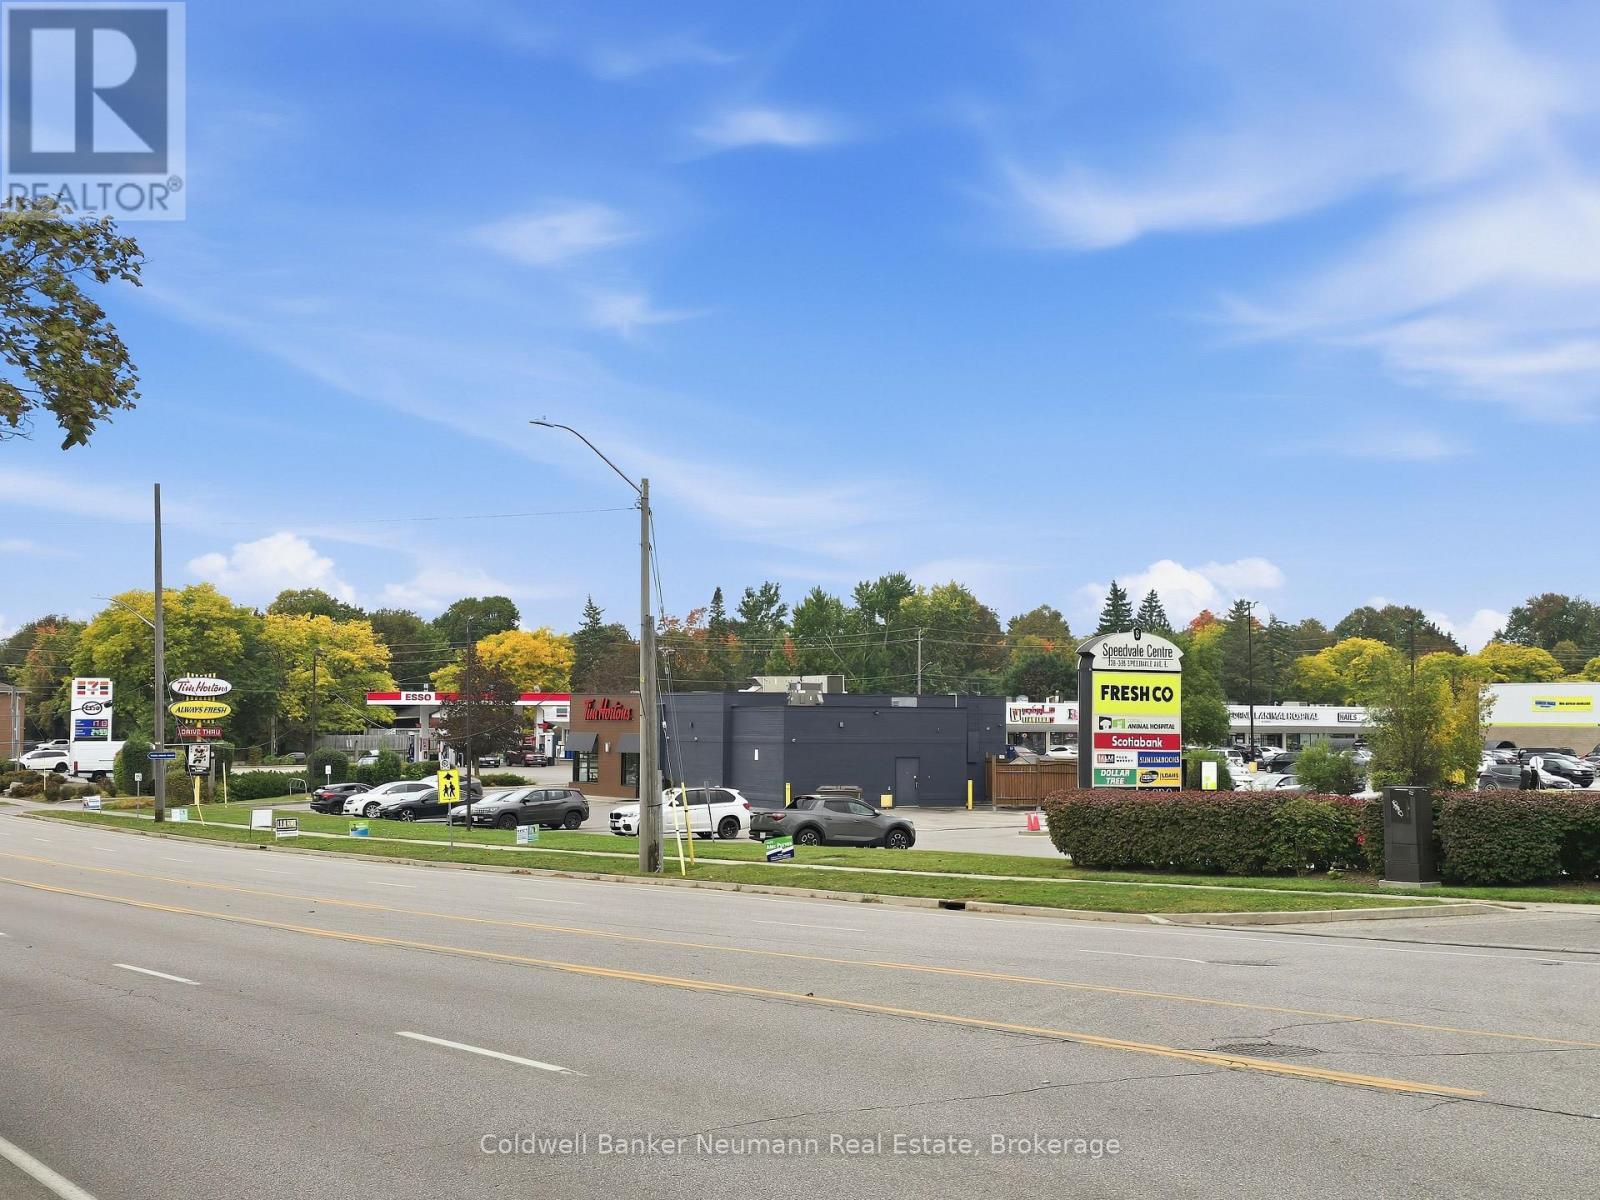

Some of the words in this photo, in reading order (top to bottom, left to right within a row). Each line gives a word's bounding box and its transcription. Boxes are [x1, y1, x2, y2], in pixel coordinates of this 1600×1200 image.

[1102, 642, 1144, 664] Speedvale
[1146, 644, 1173, 658] Centre
[177, 680, 195, 692] Tim
[195, 681, 228, 692] Hortons
[405, 693, 432, 701] ESSO
[204, 706, 227, 714] FRESH
[584, 698, 597, 720] Tim
[598, 697, 632, 720] Hortons
[1111, 735, 1163, 748] Scotiabank
[1100, 769, 1130, 777] DOLLAR
[1105, 777, 1125, 785] TREE
